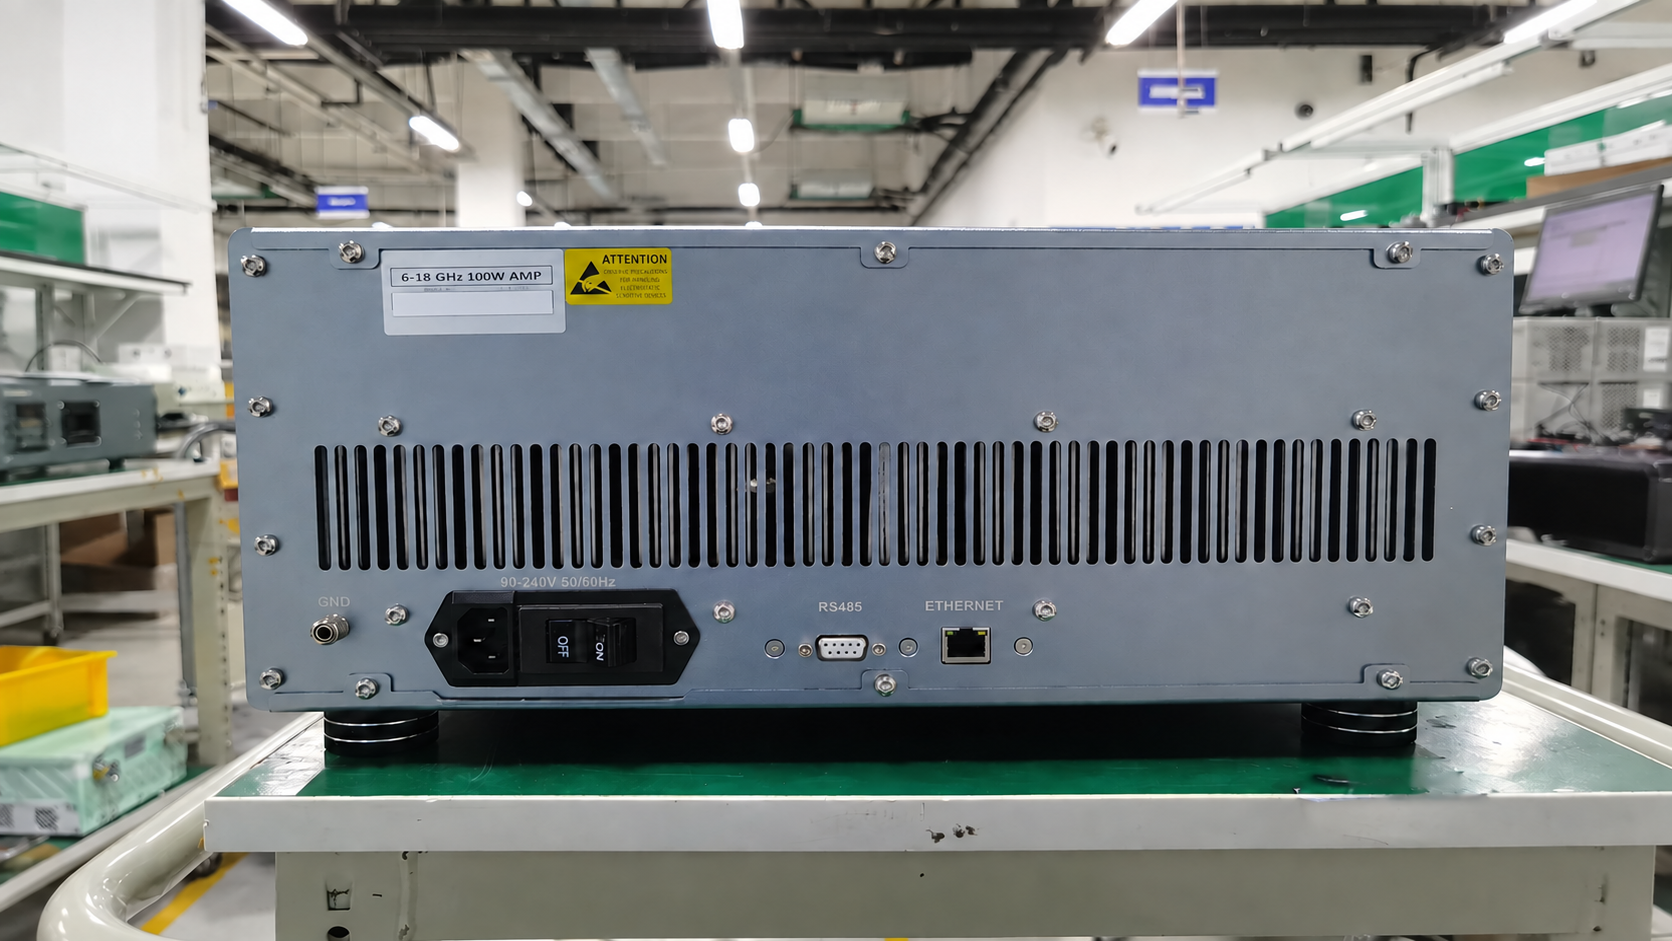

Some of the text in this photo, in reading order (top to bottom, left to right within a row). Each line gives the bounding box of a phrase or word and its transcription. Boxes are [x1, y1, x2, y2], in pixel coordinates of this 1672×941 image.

[602, 254, 667, 264] ATTENTION
[401, 271, 542, 282] 6-18 GHz 100W AMP
[500, 576, 616, 588] 90-240V 50/60Hz
[318, 596, 351, 608] GND
[818, 601, 863, 612] RS485
[925, 600, 1004, 611] ETHERNET
[557, 635, 570, 658] OFF
[595, 642, 605, 661] ON
